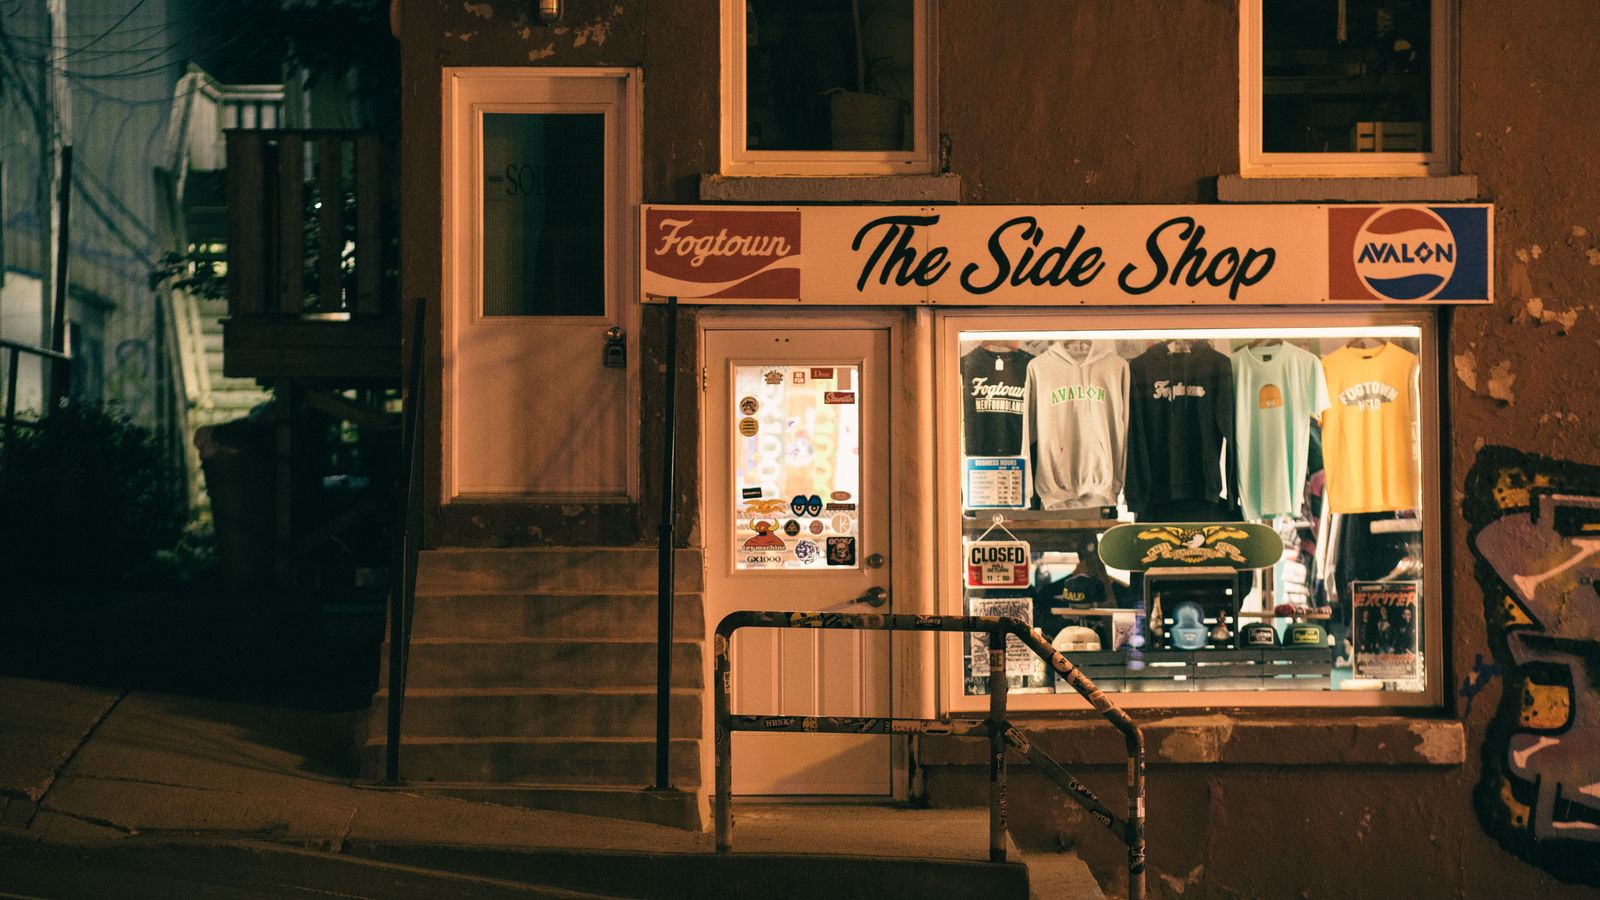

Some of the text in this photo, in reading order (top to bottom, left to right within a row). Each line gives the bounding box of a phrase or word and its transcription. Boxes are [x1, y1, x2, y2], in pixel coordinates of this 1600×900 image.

[654, 217, 791, 267] Fogtown
[1357, 241, 1453, 265] AVALON
[851, 214, 1277, 301] The Side Shop
[1051, 385, 1105, 406] AVALON
[1339, 381, 1399, 405] FOGTOWN
[972, 547, 1024, 564] CLOSED
